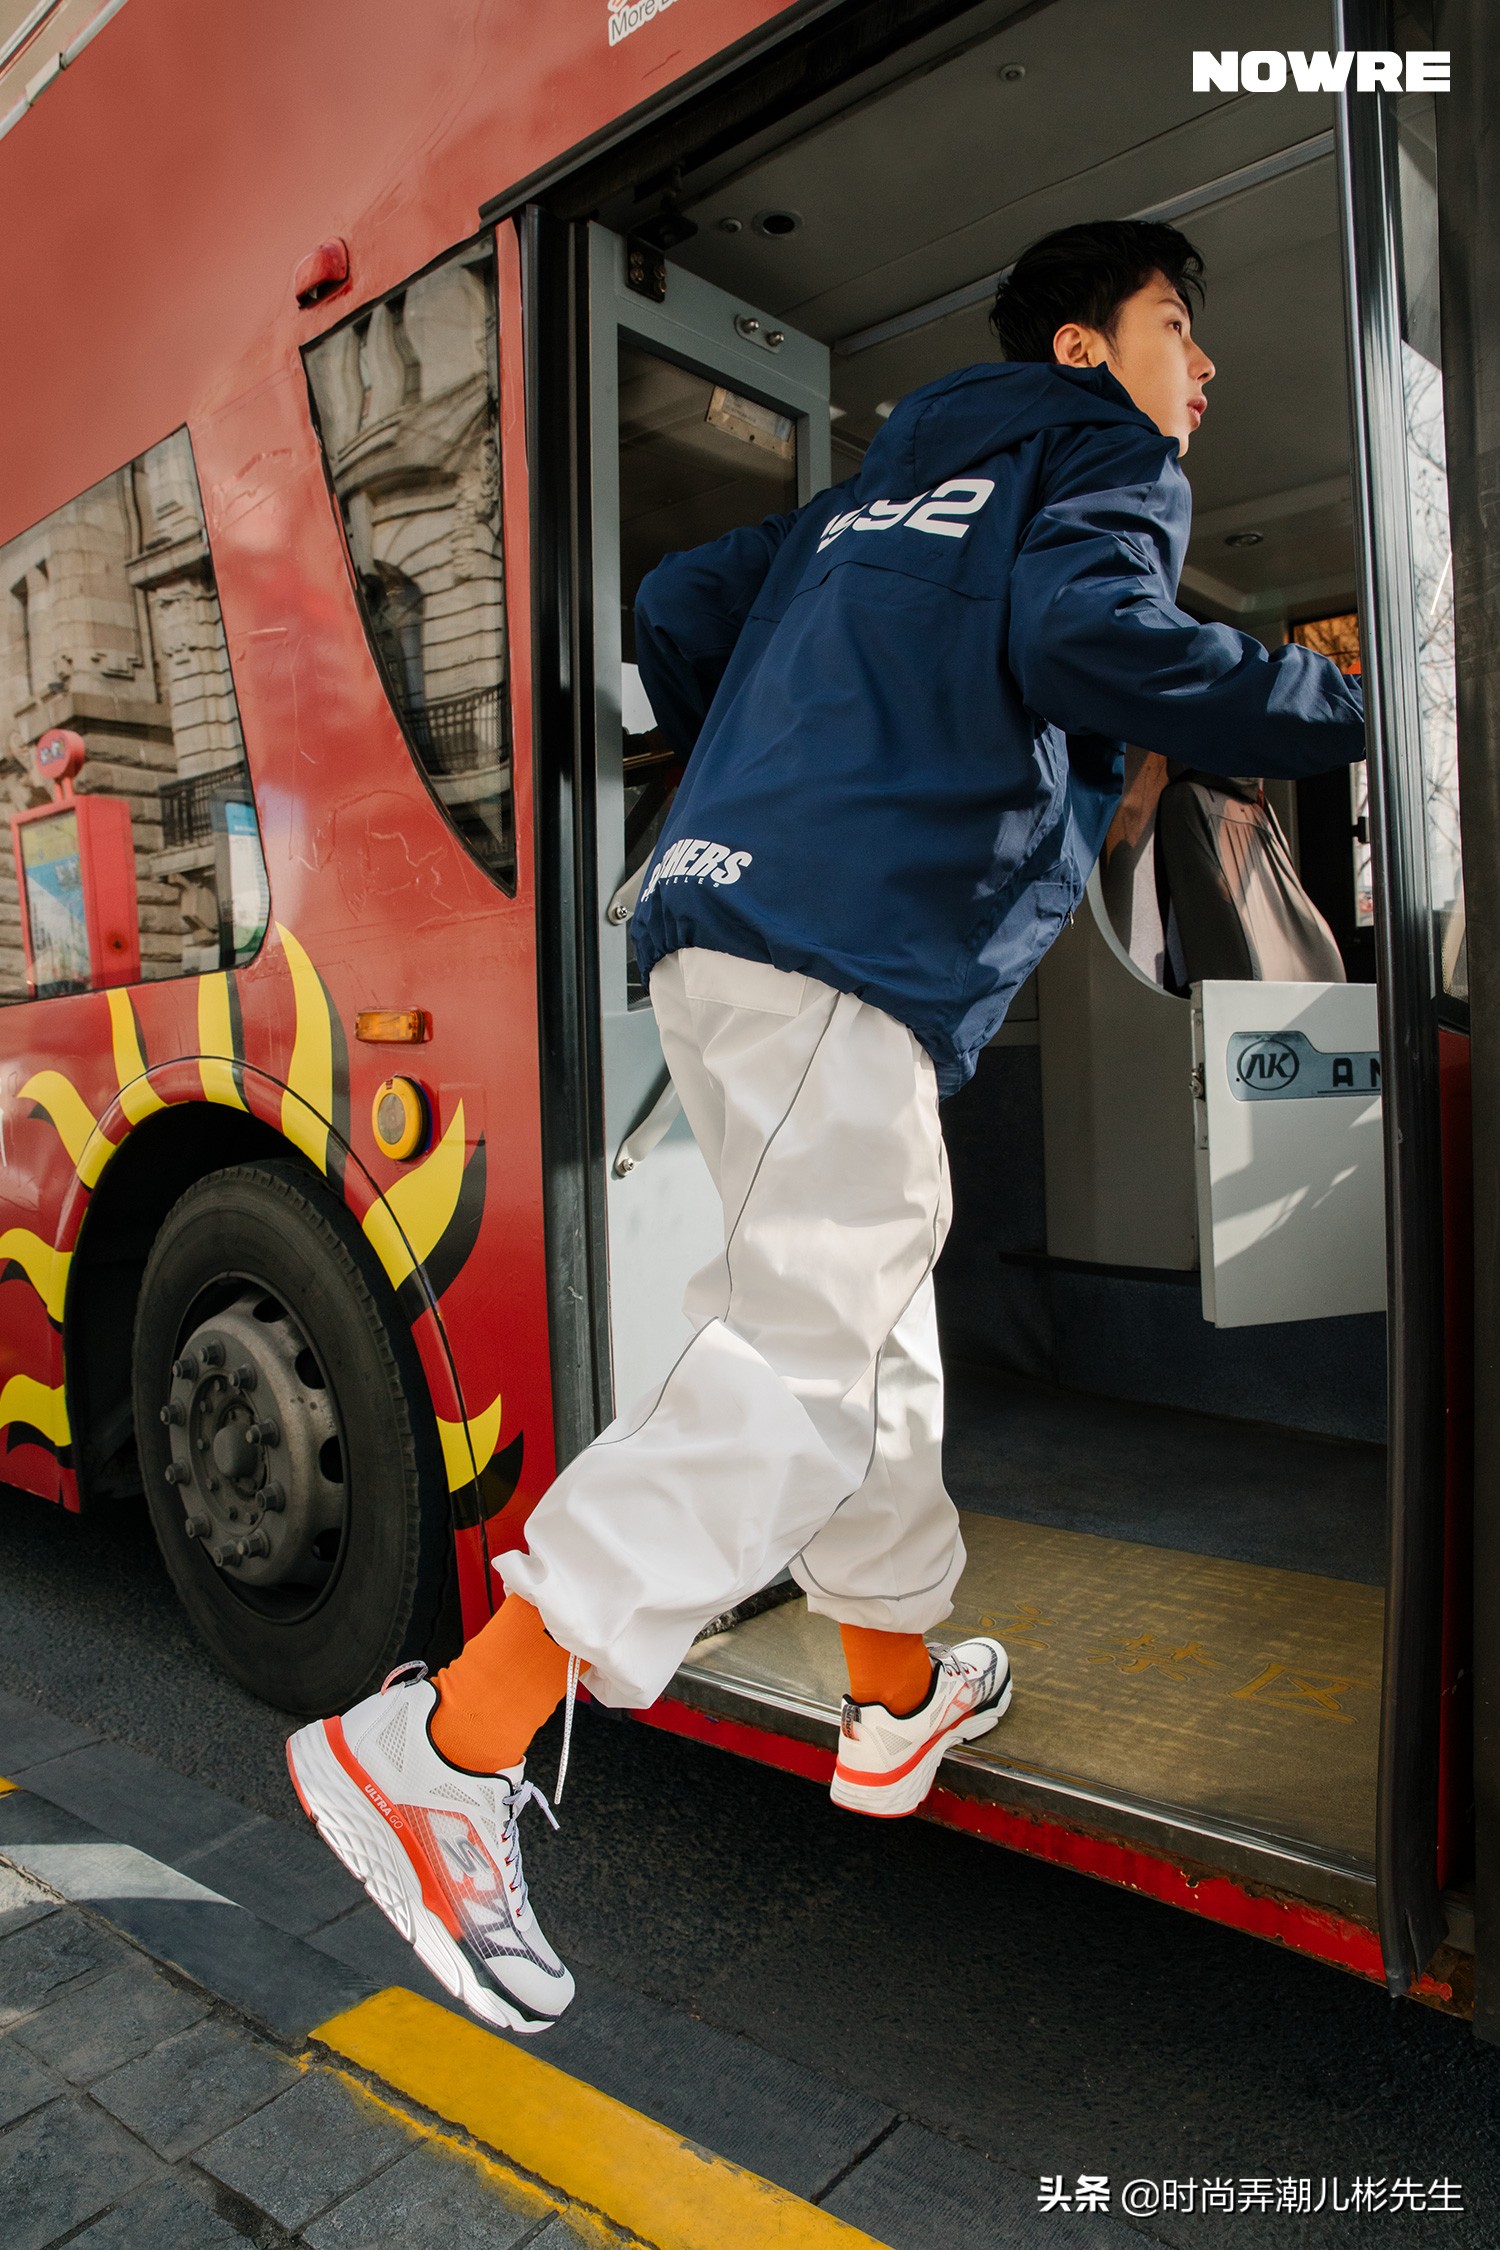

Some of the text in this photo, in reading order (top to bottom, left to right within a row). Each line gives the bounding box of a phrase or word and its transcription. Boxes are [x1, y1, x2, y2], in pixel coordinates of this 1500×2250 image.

[611, 0, 655, 41] More
[364, 1784, 404, 1829] ULTRA GO
